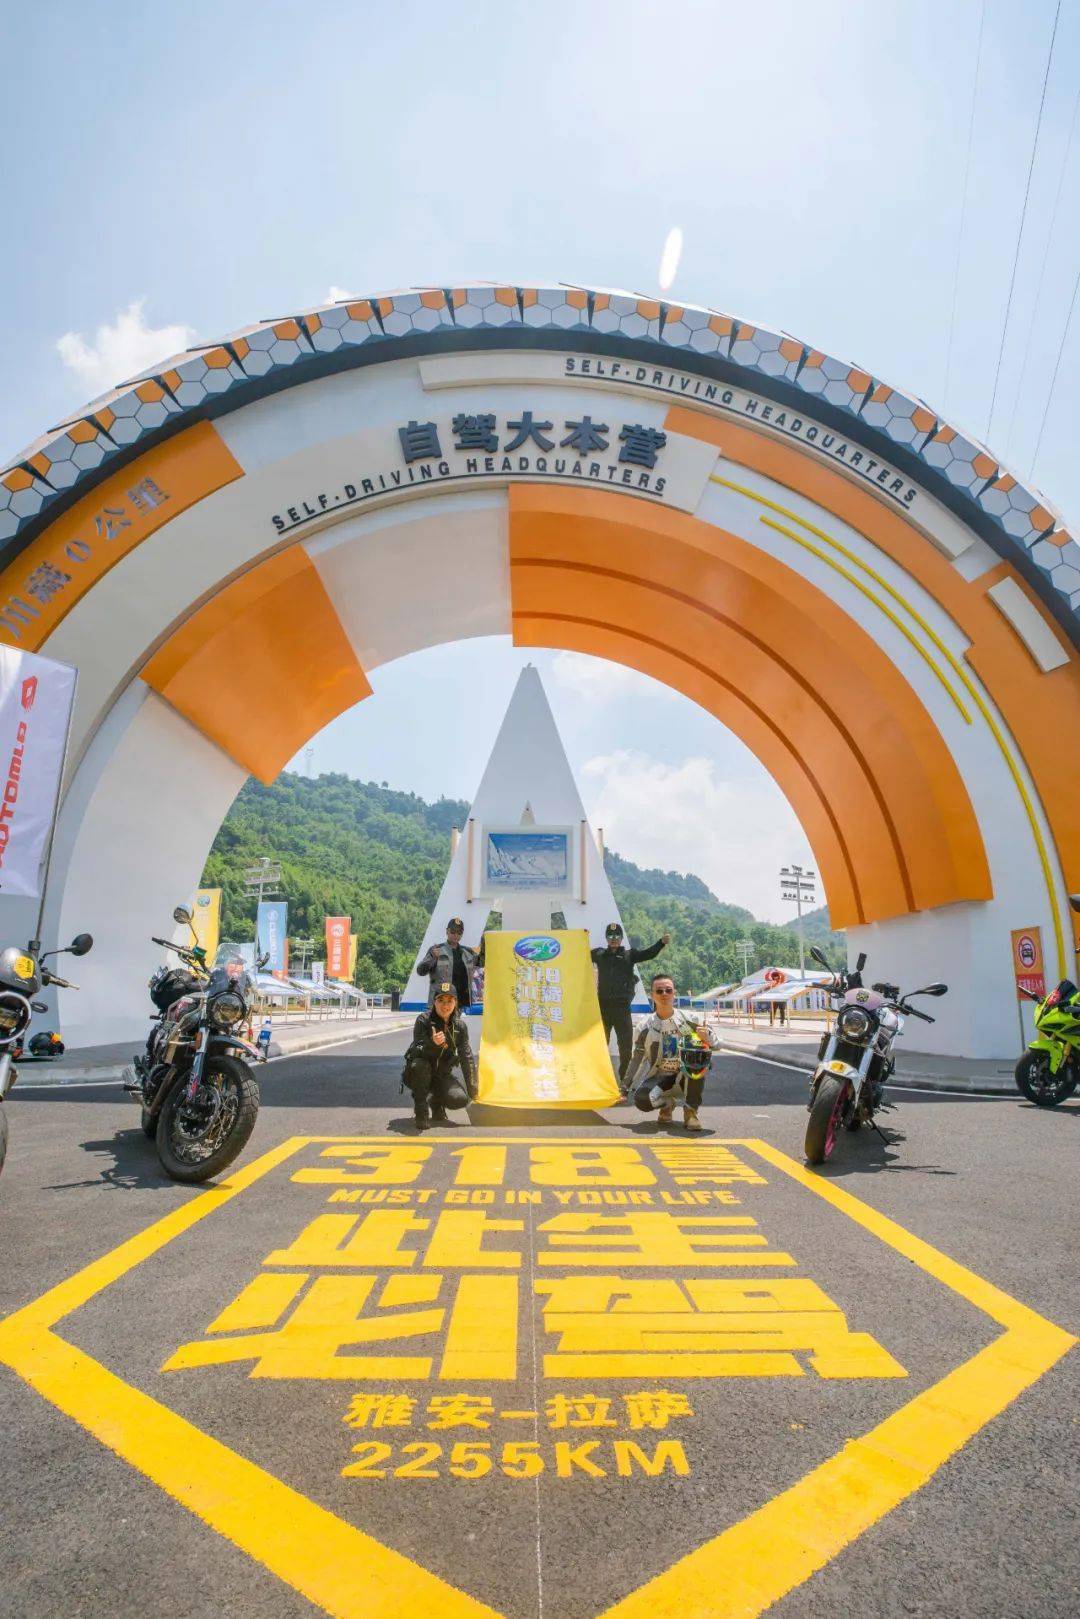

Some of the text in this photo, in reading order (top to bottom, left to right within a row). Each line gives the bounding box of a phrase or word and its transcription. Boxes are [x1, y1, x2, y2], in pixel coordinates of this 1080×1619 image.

[398, 411, 668, 469] 自驾大本营
[745, 398, 919, 504] HEADQUARTERS
[466, 456, 668, 492] HEADQUARTERS
[289, 1145, 658, 1185] 318
[327, 1188, 742, 1205] MUST GO IN YOUR LIFE
[261, 1209, 798, 1268] 此生
[160, 1273, 909, 1381] 必驾
[341, 1440, 693, 1479] 2255KM
